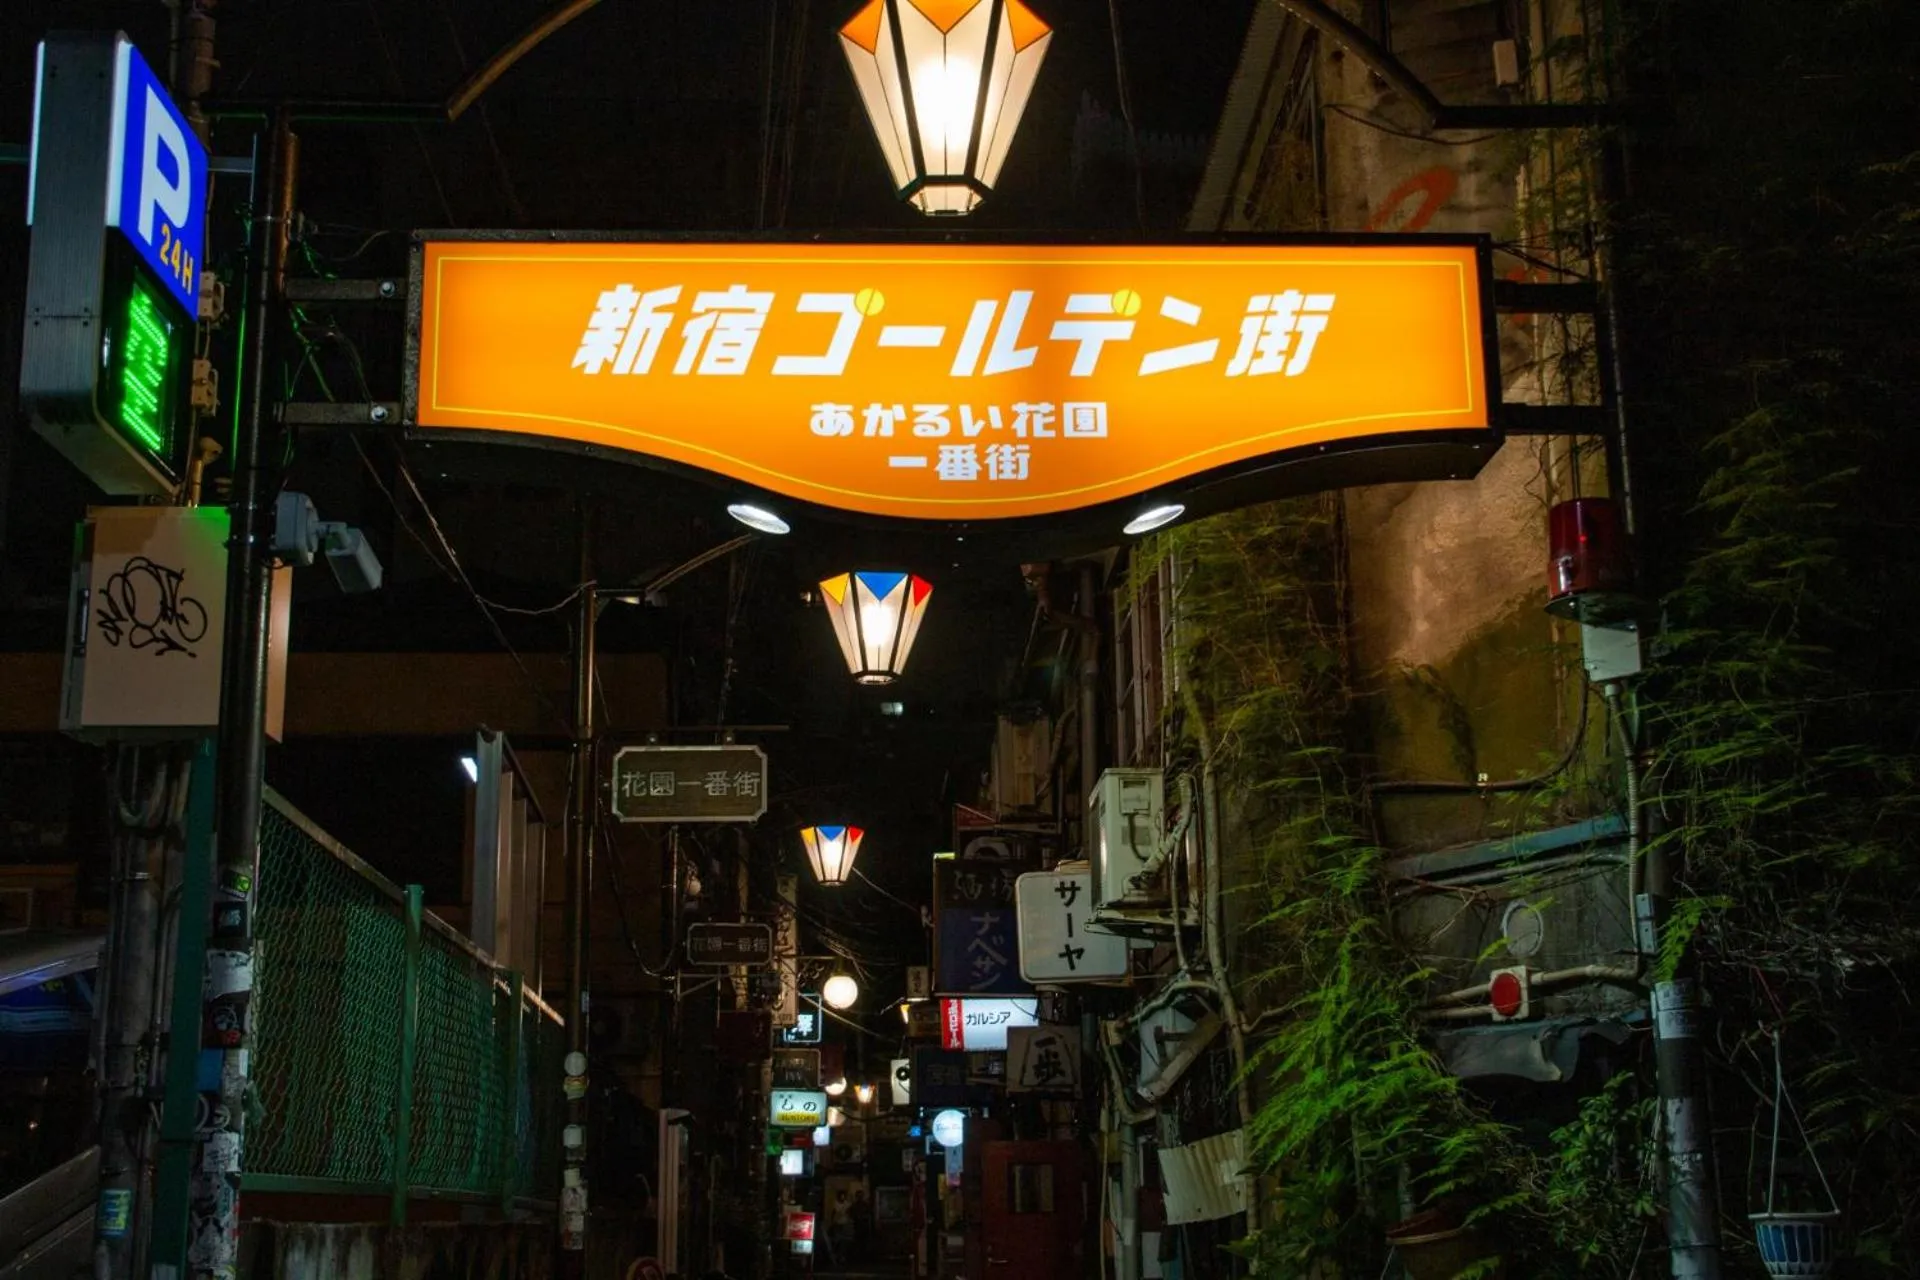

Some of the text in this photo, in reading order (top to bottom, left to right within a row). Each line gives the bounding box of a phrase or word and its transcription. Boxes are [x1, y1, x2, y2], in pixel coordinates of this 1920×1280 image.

[138, 84, 191, 246] P
[159, 224, 194, 295] 24H
[572, 283, 1336, 378] 新宿ゴールデン街
[810, 402, 1108, 439] あかるい花園
[888, 444, 1032, 482] 一番街
[621, 771, 761, 798] 花園一番街
[967, 911, 1008, 992] ナベサン
[1054, 880, 1085, 971] サーヤ
[965, 1011, 1011, 1026] ガルシア
